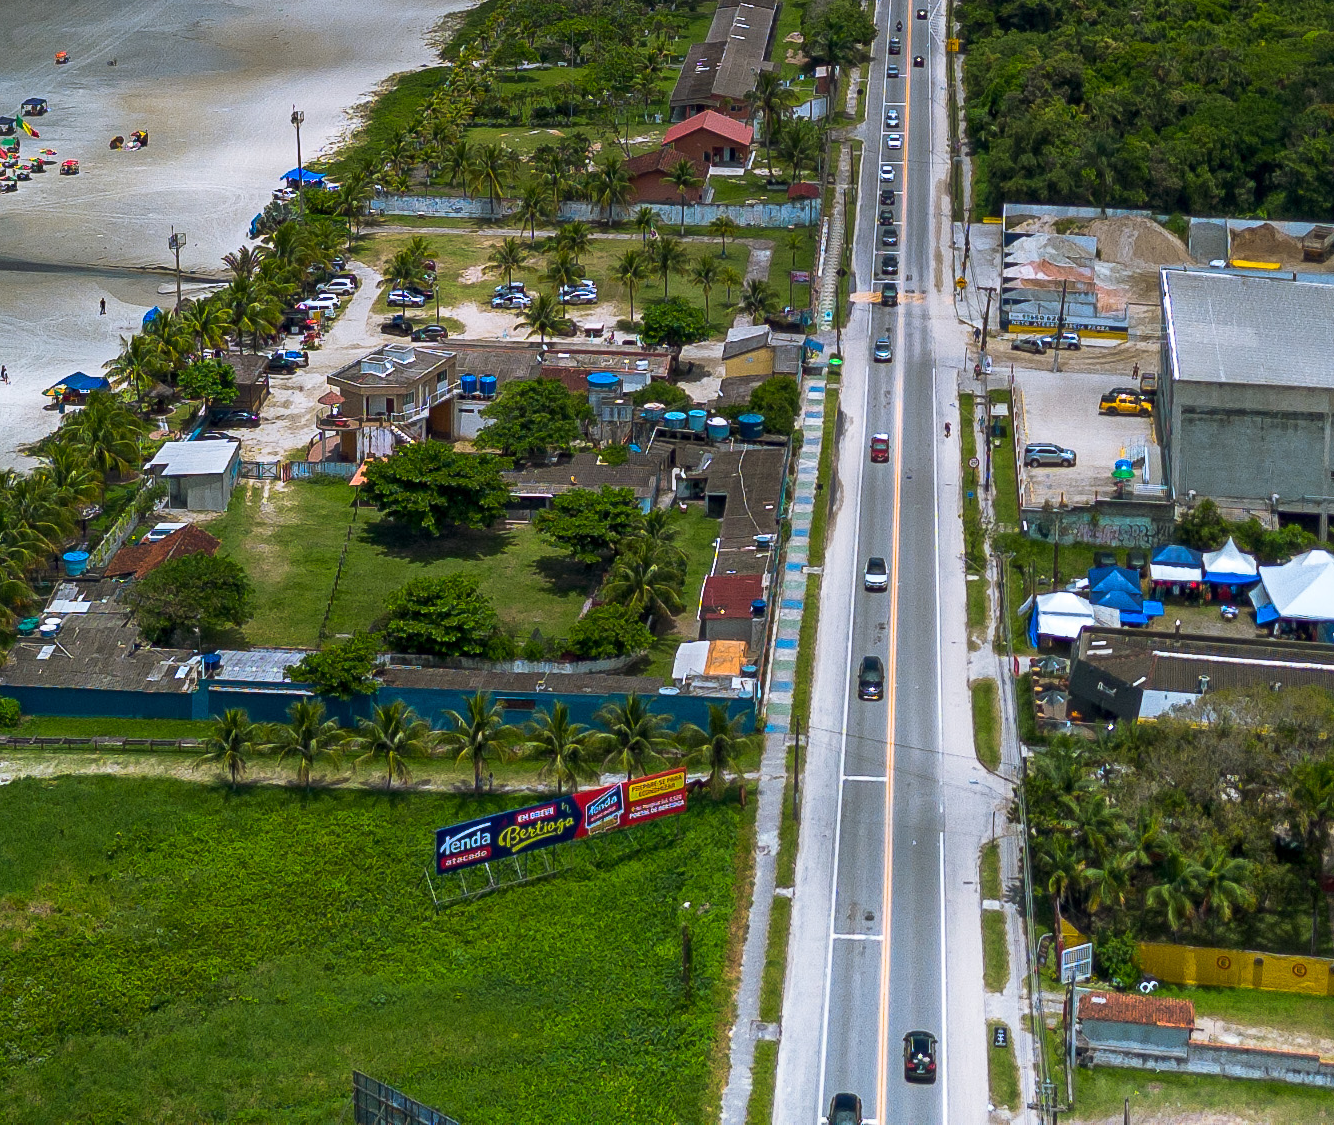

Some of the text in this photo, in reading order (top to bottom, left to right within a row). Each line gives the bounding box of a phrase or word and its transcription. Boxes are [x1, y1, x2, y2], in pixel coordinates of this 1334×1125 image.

[518, 813, 529, 823] EM
[498, 817, 574, 848] Bertioga
[445, 850, 487, 866] atacado
